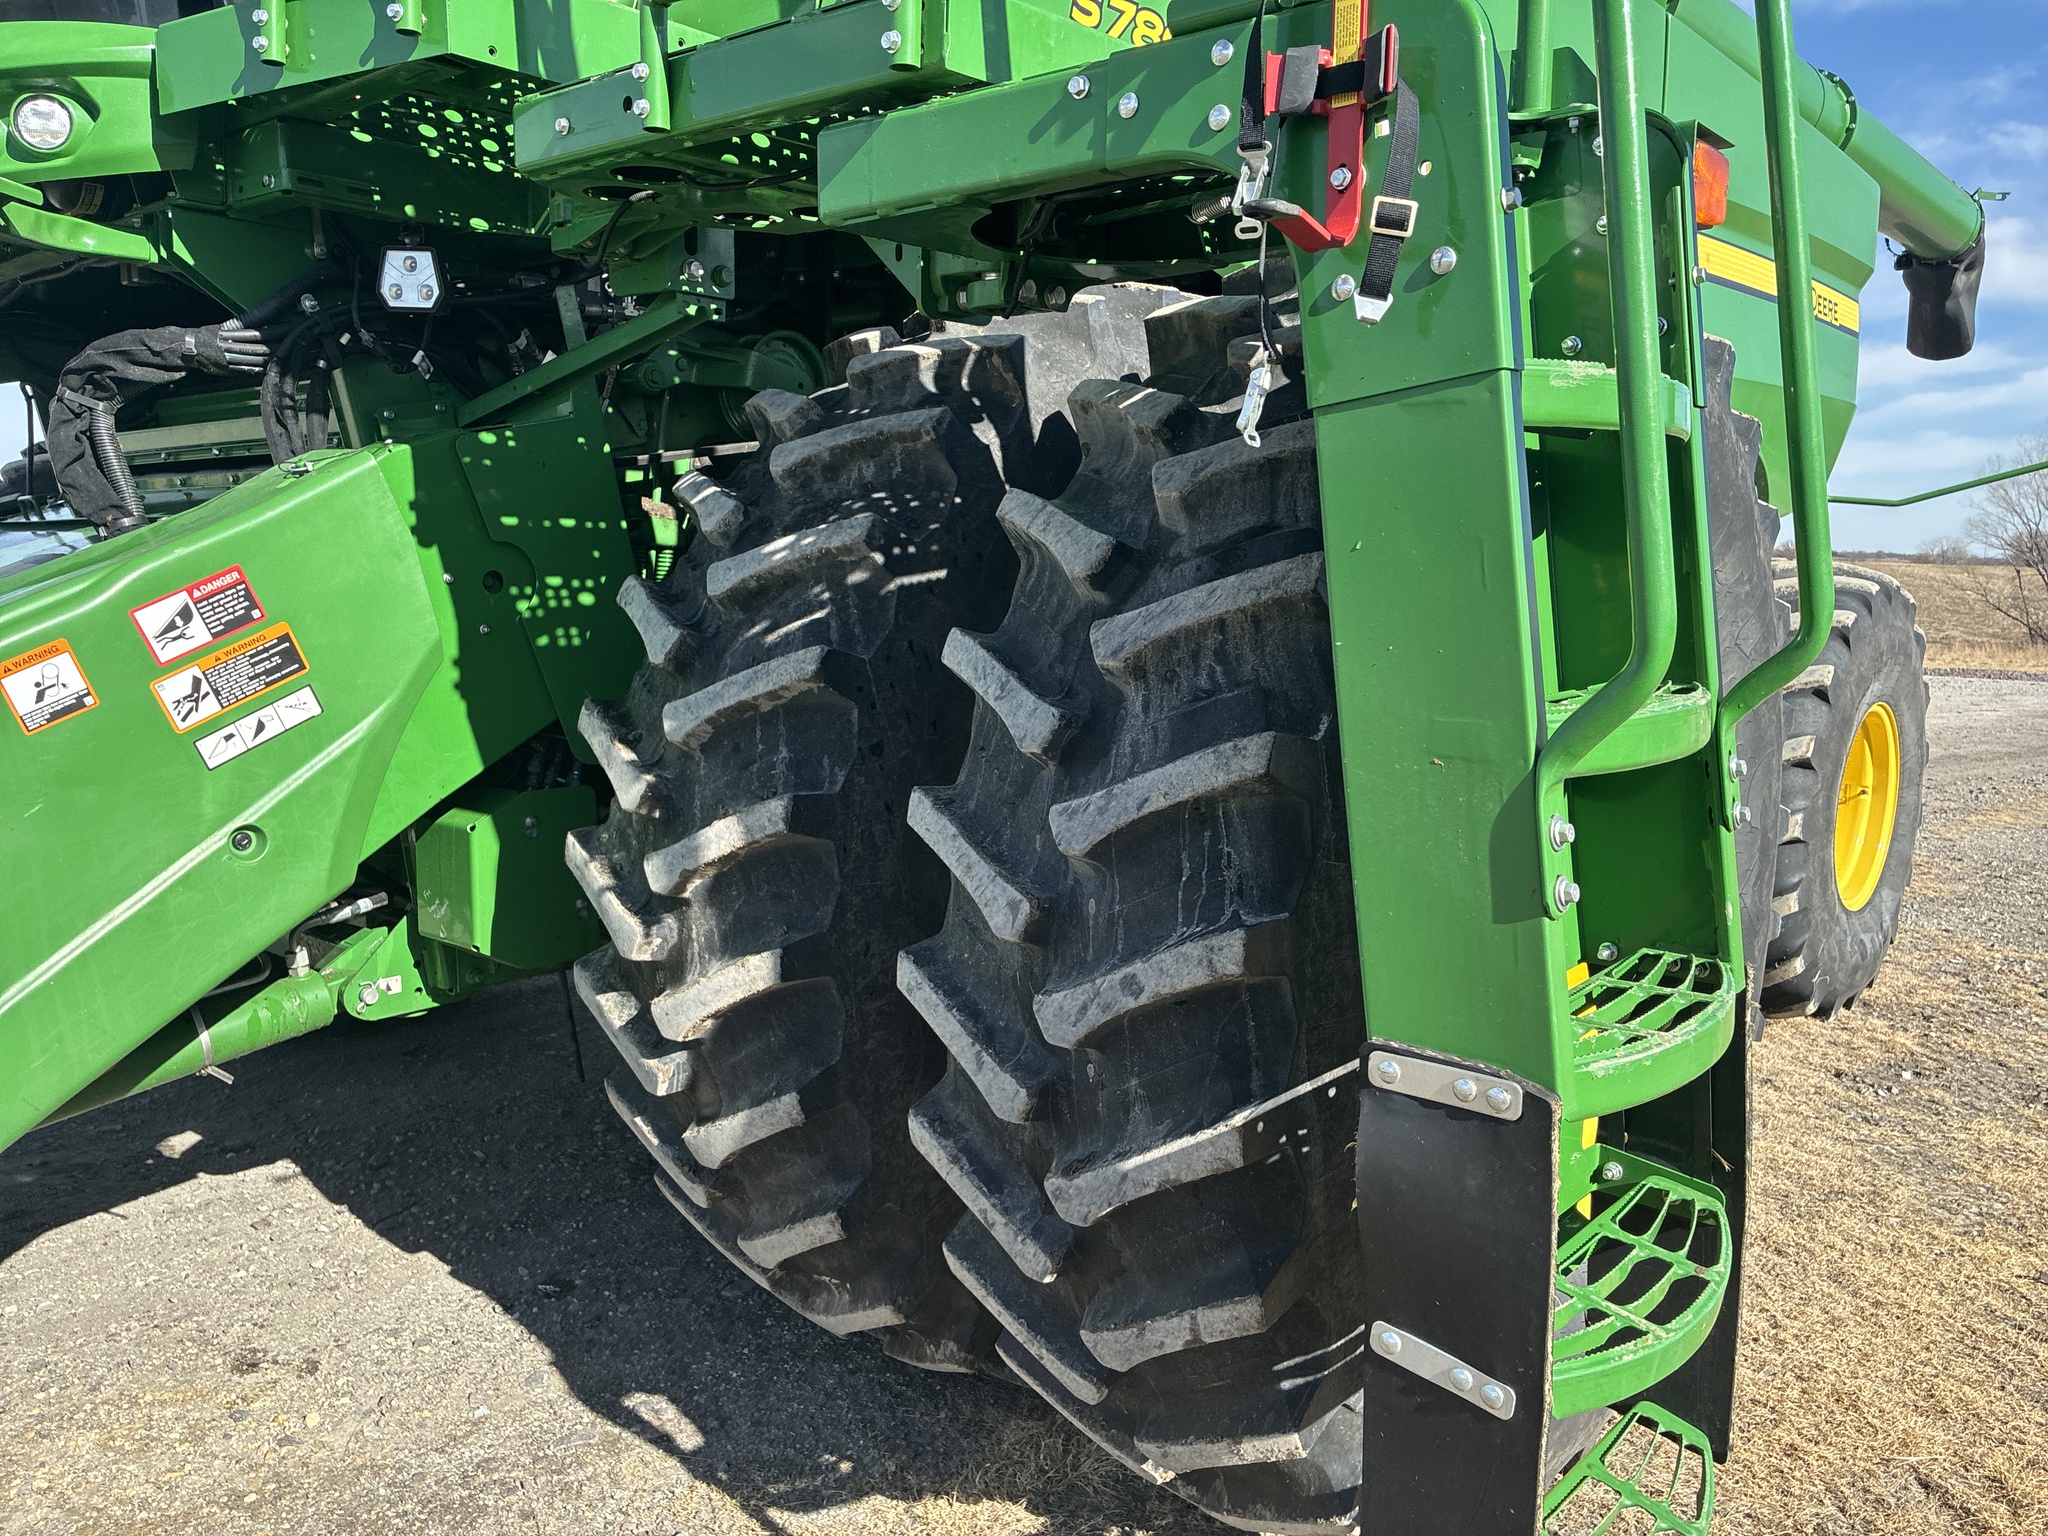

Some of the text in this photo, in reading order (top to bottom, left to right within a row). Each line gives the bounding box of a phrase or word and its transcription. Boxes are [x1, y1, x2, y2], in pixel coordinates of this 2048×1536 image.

[1070, 0, 1173, 48] S78
[199, 571, 241, 595] DANGER
[12, 645, 60, 669] WARNING
[223, 634, 267, 658] WARNING
